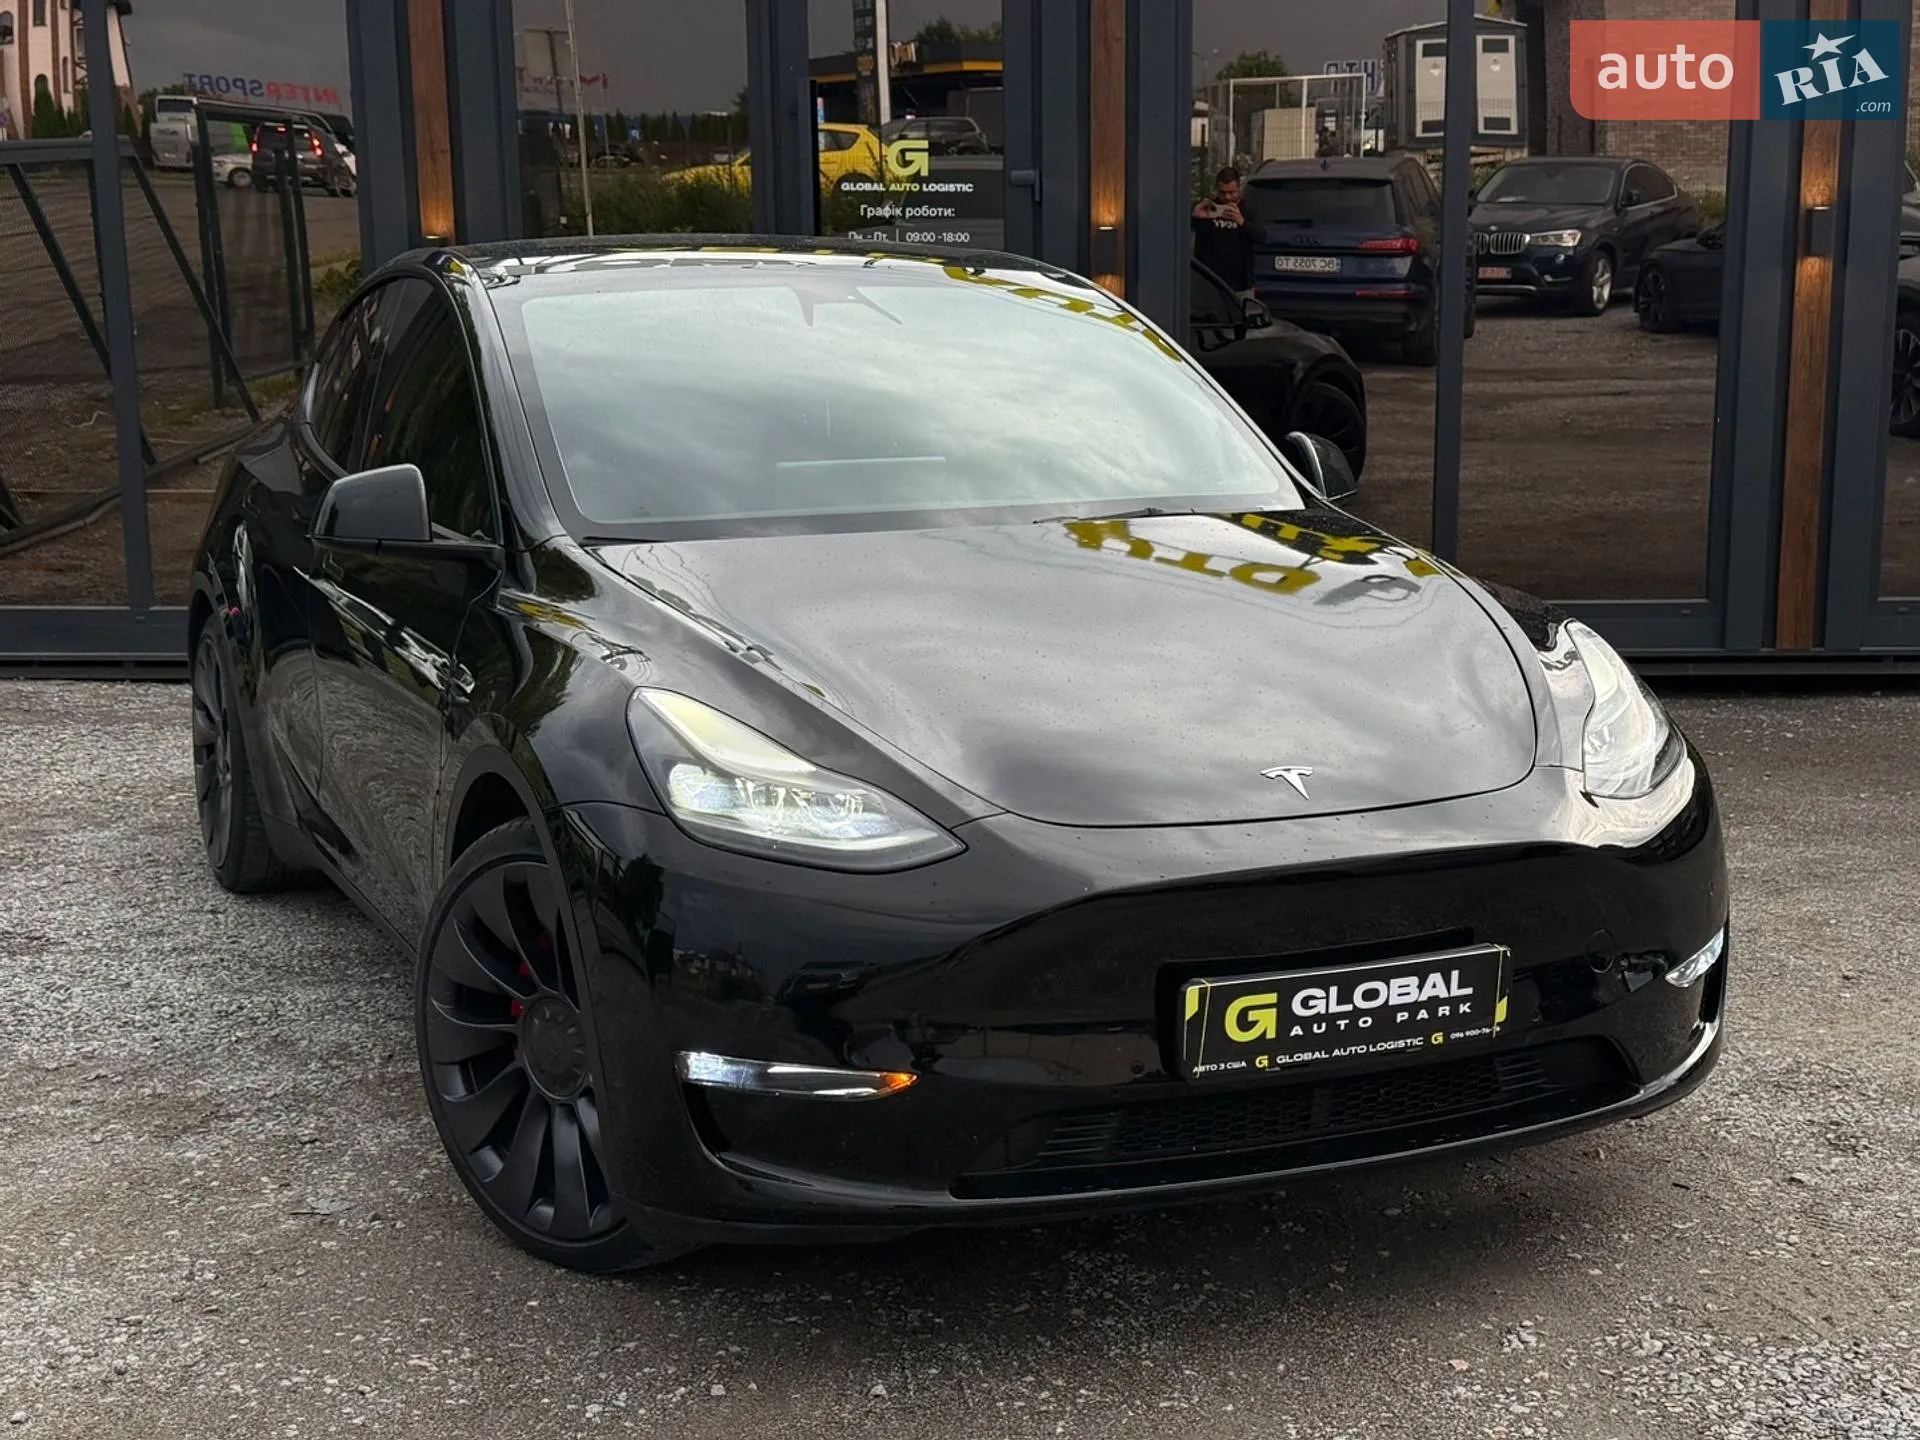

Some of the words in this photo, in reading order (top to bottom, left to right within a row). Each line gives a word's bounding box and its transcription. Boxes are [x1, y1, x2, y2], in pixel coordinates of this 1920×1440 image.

[841, 182, 886, 192] GLOBAL
[889, 182, 920, 192] AUTO
[922, 182, 974, 192] LOGISTIC
[860, 202, 902, 219] Графік
[905, 205, 956, 219] роботи:
[906, 232, 935, 242] 09:00
[1291, 970, 1473, 1017] GLOBAL
[1225, 992, 1278, 1043] G
[1289, 1016, 1373, 1037] AUTO
[1396, 1002, 1472, 1023] PARK
[1276, 1049, 1330, 1064] GLOBAL
[1332, 1043, 1367, 1057] AUTO
[1369, 1037, 1424, 1052] LOGISTIC
